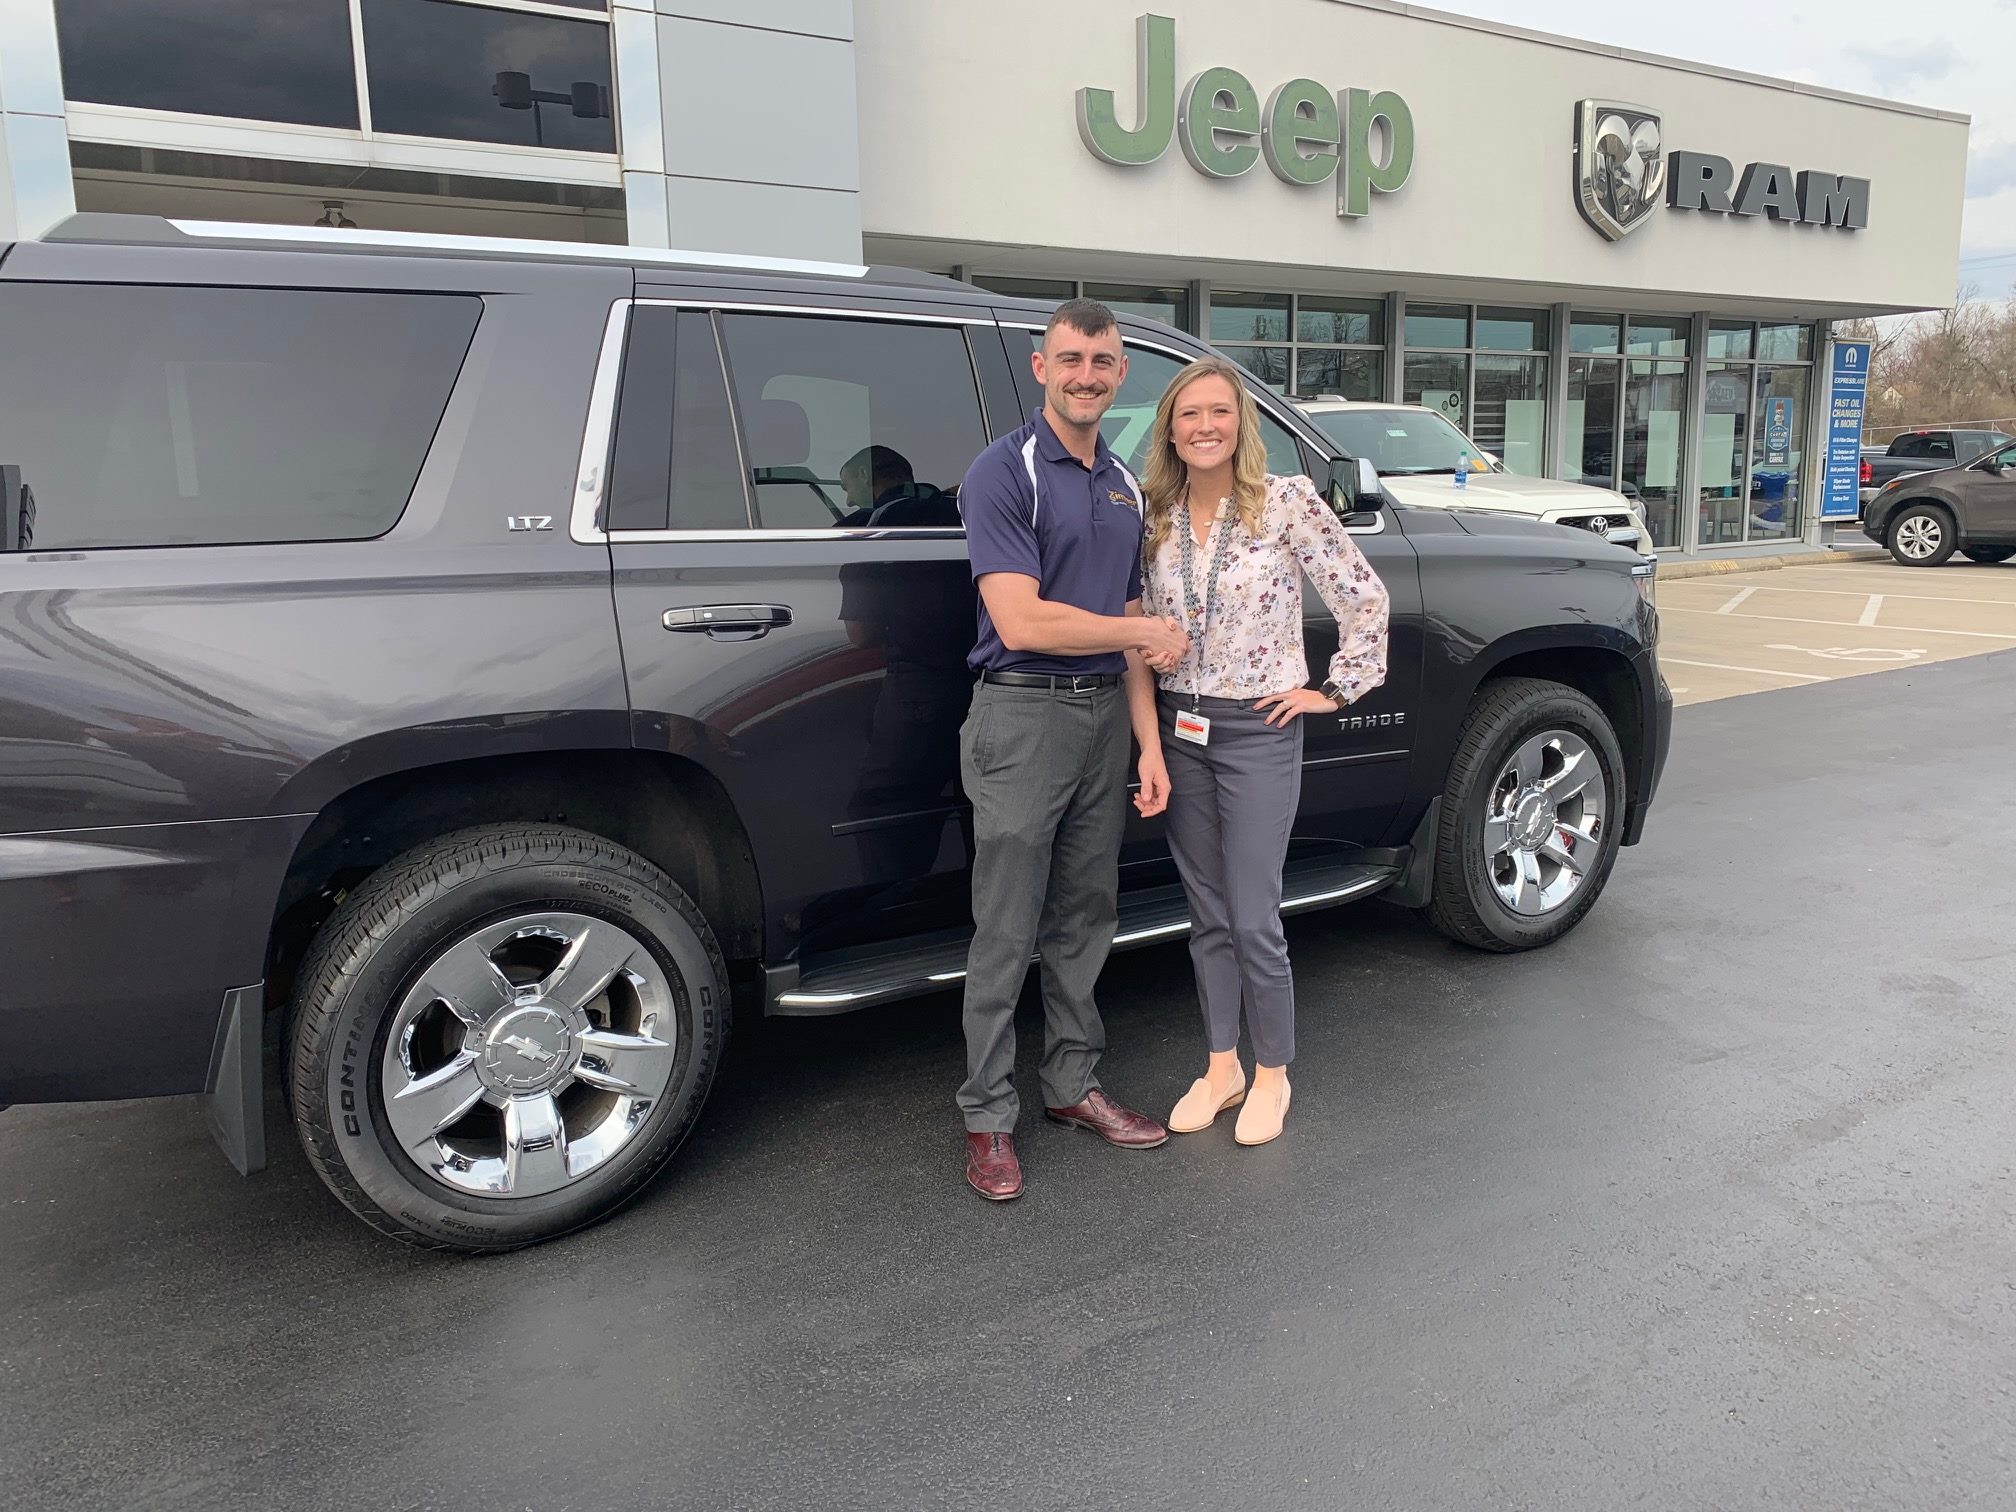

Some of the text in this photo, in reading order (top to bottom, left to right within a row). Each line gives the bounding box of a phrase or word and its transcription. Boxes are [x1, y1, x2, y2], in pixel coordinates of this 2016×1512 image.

[1075, 12, 1415, 219] Jeep
[1666, 150, 1871, 229] RAM
[1834, 398, 1860, 408] FAST OIL
[1832, 409, 1861, 418] CHANGES
[1834, 419, 1858, 428] & MORE
[508, 516, 553, 531] LTZ
[1338, 712, 1405, 730] TAHOE
